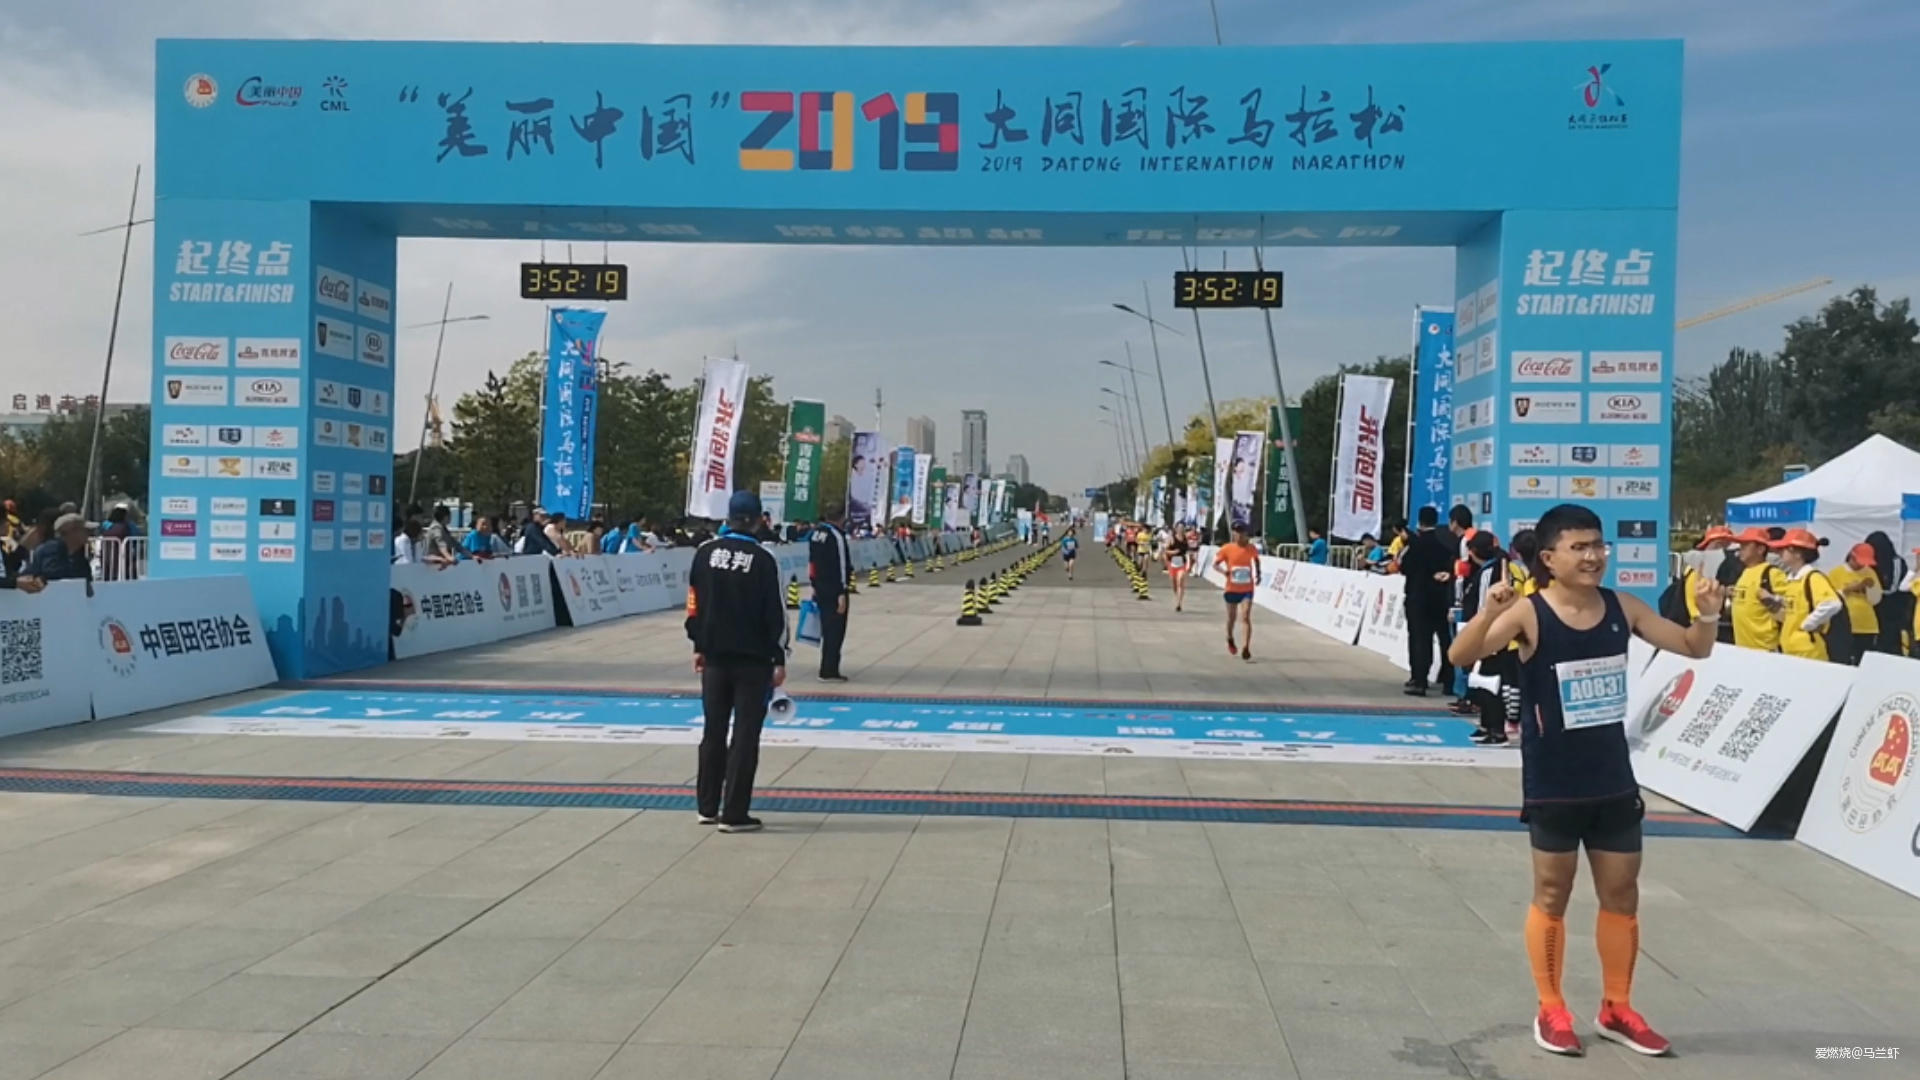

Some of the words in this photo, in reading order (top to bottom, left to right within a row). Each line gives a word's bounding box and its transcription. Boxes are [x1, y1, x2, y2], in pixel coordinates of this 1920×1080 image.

[320, 100, 351, 112] CML
[739, 91, 959, 171] 2019
[978, 85, 1407, 150] 大同国际马拉松
[981, 156, 1023, 172] 2019
[1042, 155, 1121, 172] DATONG
[1140, 155, 1274, 171] INTERNATION
[1292, 154, 1406, 171] MARATHON
[175, 239, 293, 276] 起终点
[1523, 248, 1654, 286] 起终点
[169, 282, 295, 304] START&FINISH
[527, 268, 619, 294] 3:52:19
[1182, 277, 1278, 302] 3:52:19
[1516, 293, 1656, 316] START&FINISH
[709, 547, 754, 573] 裁判
[420, 589, 485, 620] 中国田径协会
[139, 613, 253, 660] 中国田径协会
